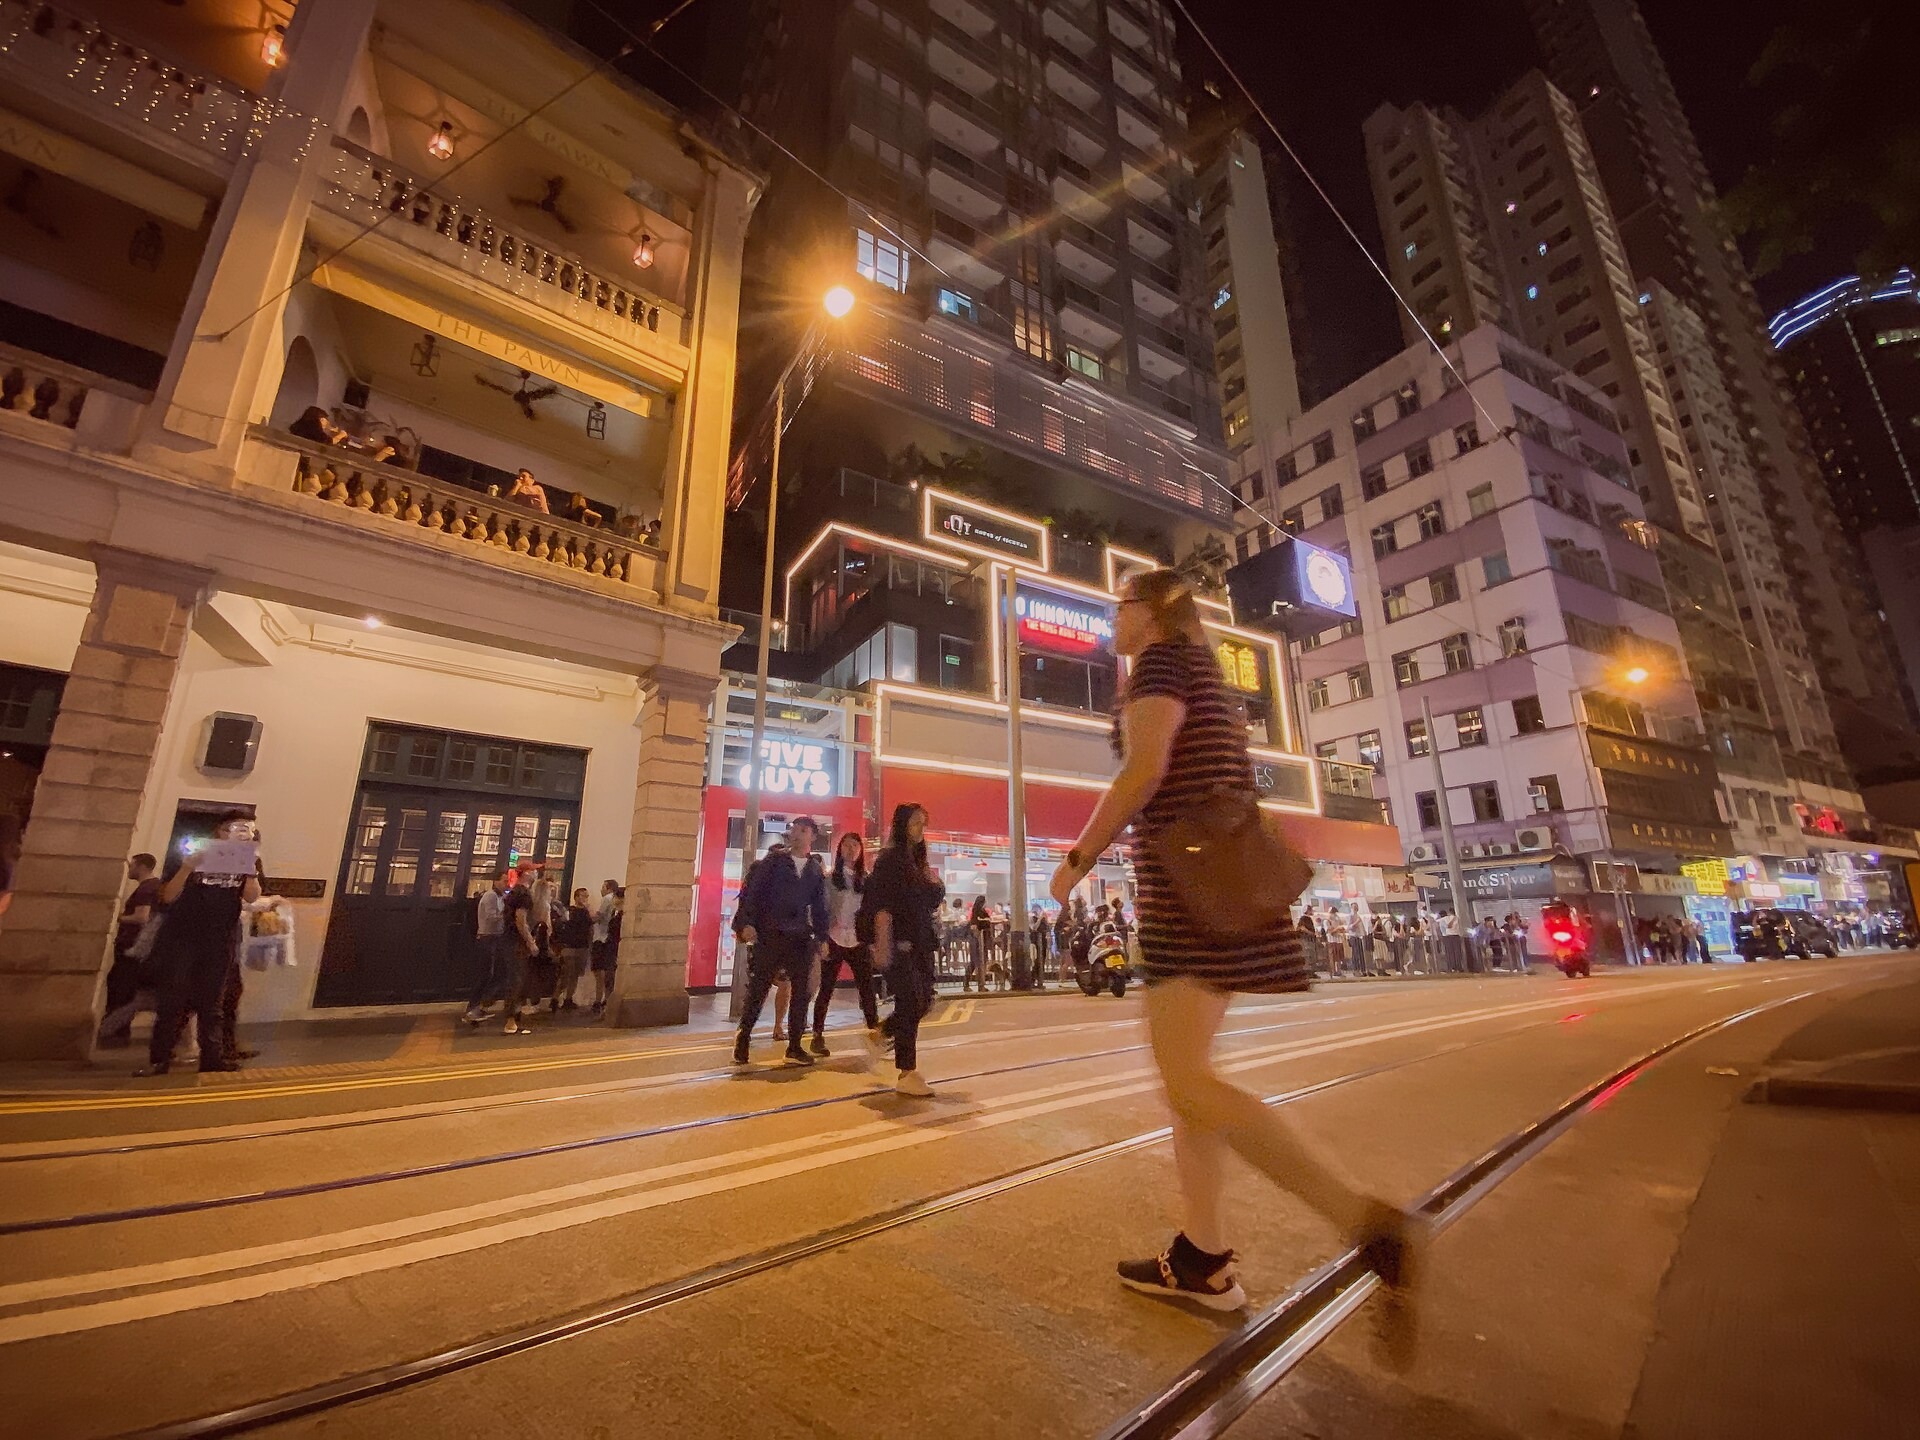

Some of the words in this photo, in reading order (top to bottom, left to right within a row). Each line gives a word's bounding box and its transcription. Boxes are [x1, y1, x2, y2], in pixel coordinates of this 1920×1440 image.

[436, 314, 491, 347] THE
[505, 342, 581, 384] PAWN
[1025, 618, 1039, 631] THE
[759, 739, 823, 770] FIVE
[739, 762, 831, 796] GUYS
